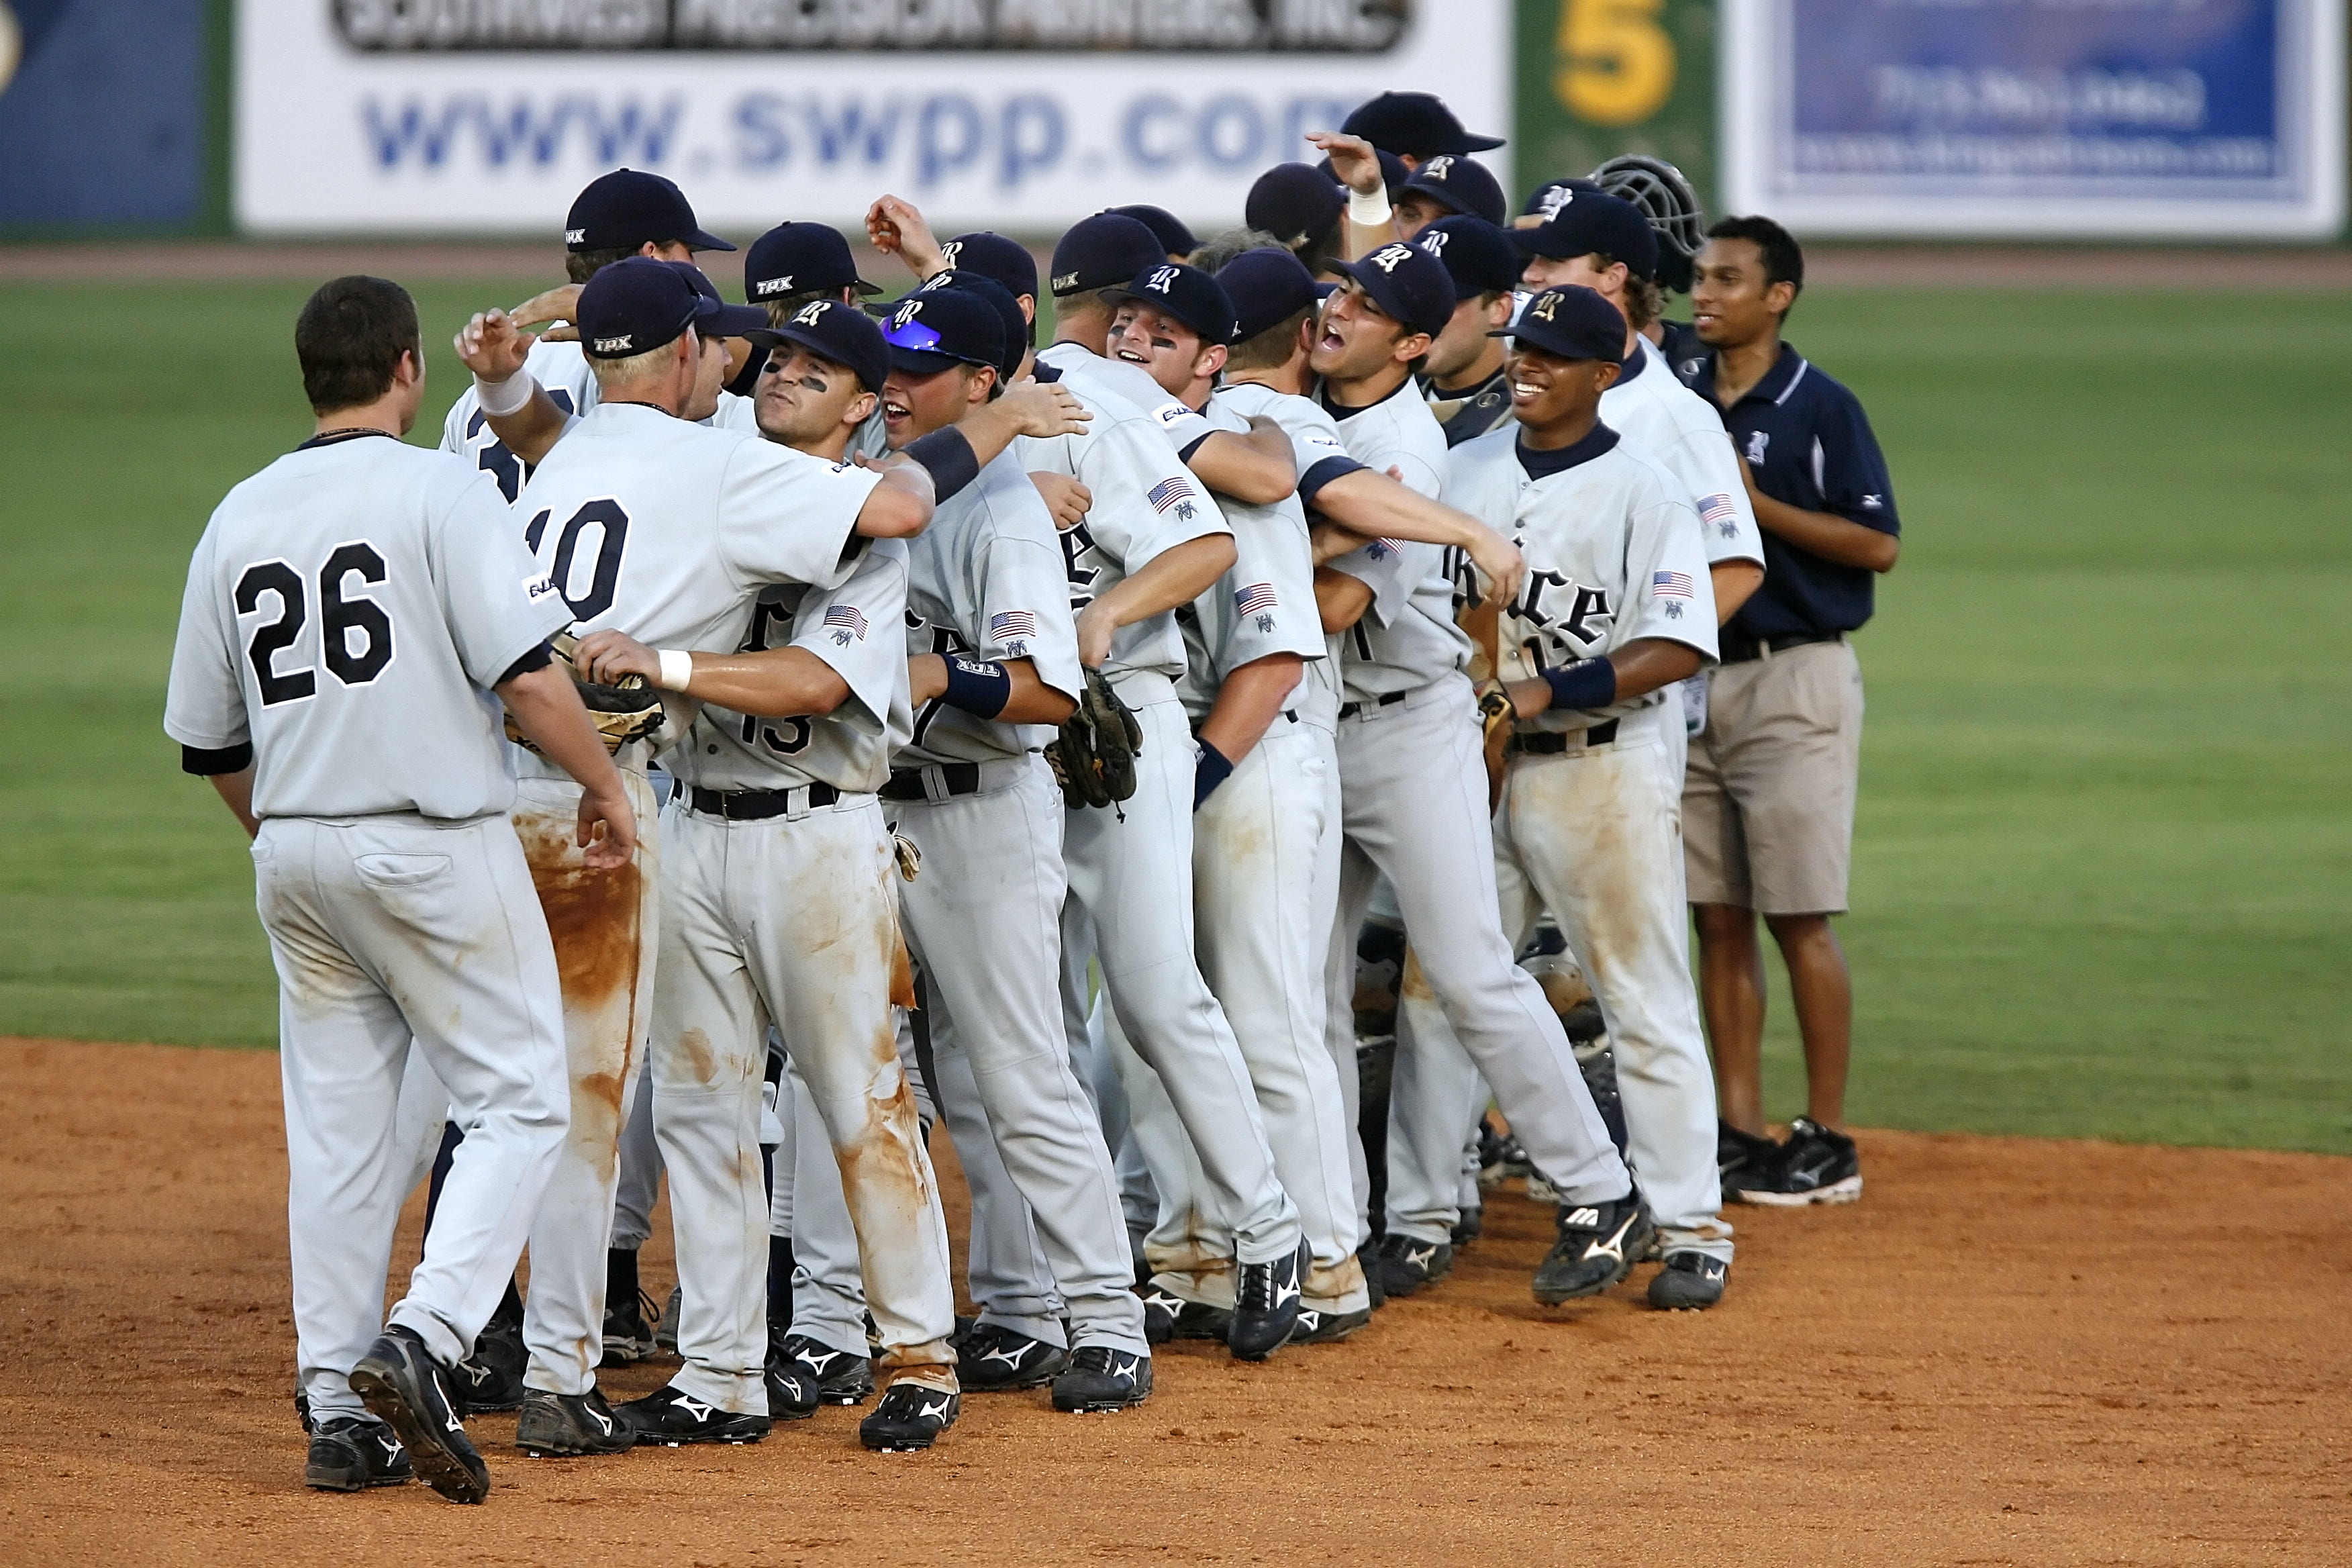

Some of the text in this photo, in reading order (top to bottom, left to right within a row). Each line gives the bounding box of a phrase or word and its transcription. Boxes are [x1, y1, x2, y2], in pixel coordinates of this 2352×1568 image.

[756, 275, 793, 295] TPX
[1145, 265, 1181, 294] R
[792, 301, 832, 327] R
[594, 334, 633, 352] TPX
[232, 539, 397, 709] 26
